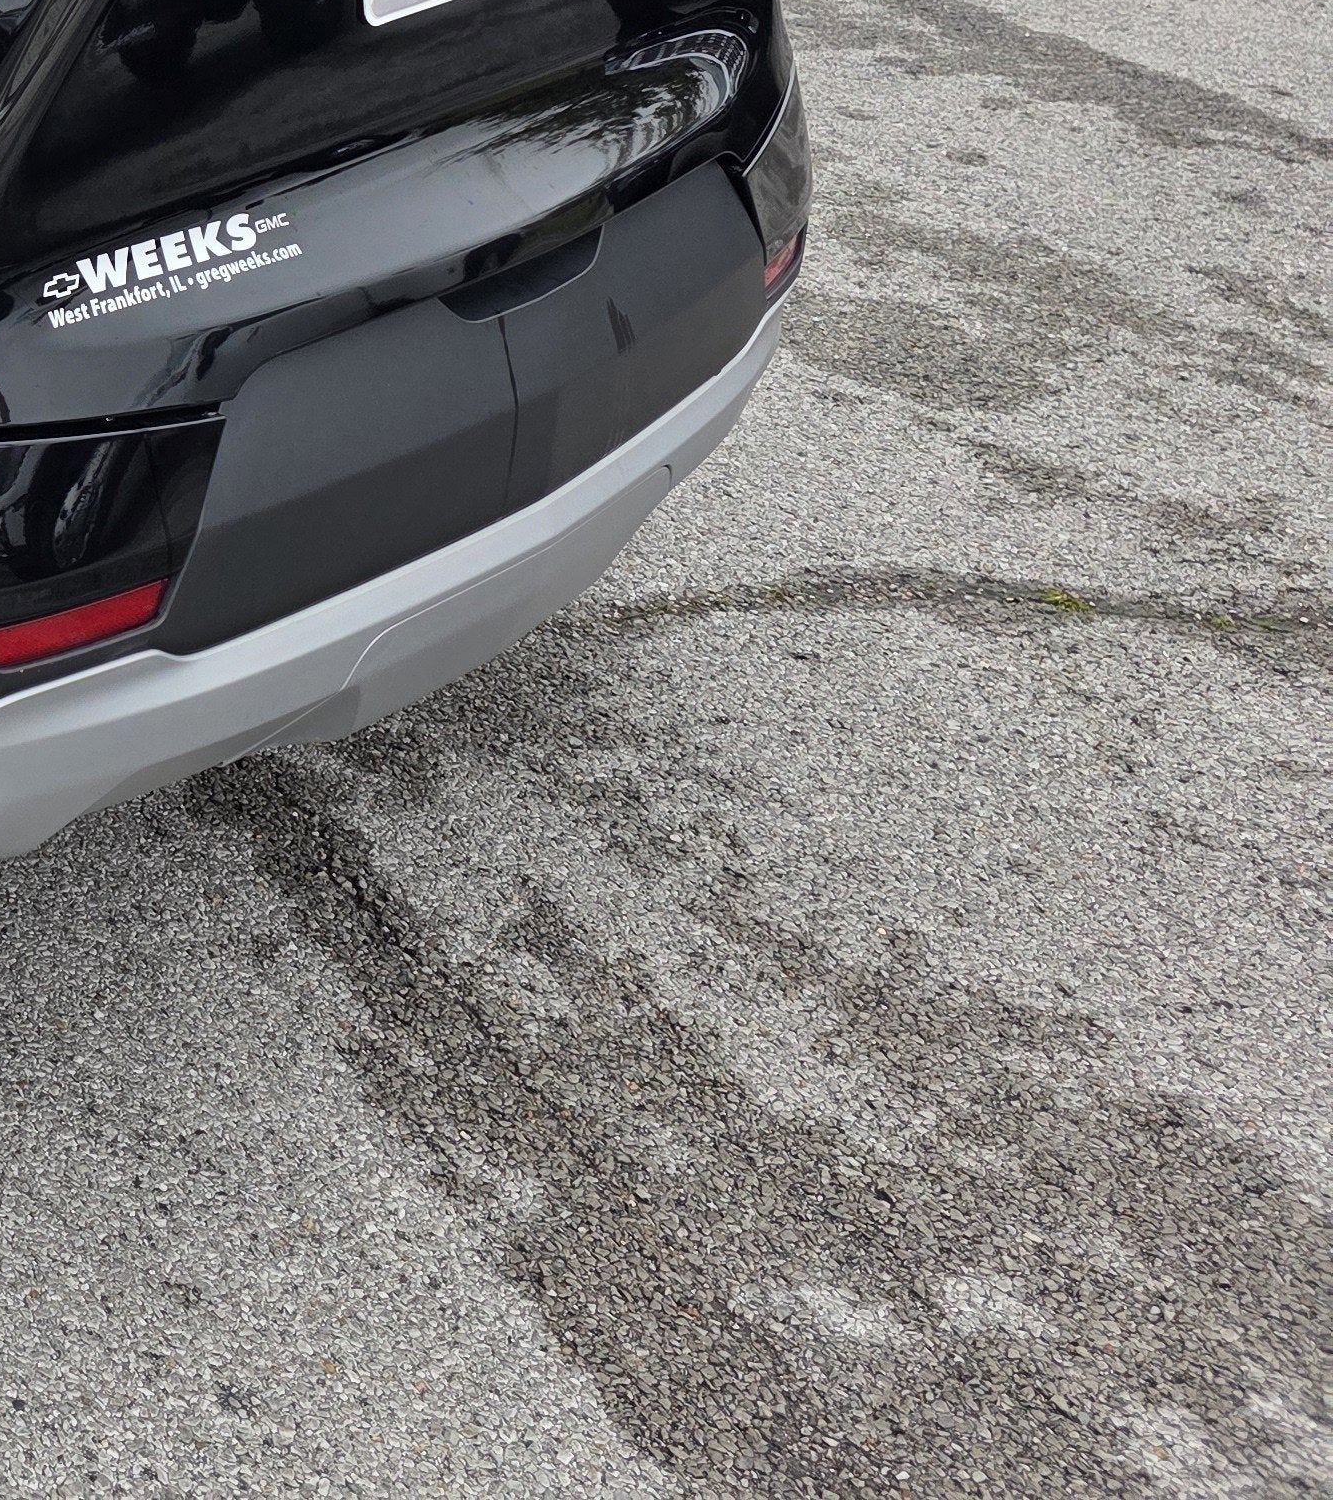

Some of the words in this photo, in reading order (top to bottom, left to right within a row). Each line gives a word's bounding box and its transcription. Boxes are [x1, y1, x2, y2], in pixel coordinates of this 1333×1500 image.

[47, 303, 91, 329] West
[90, 280, 172, 320] Frankfort,
[169, 275, 188, 294] IL
[196, 242, 303, 291] gregweeks.com
[75, 212, 257, 295] WEEKS
[254, 212, 290, 234] GMC
